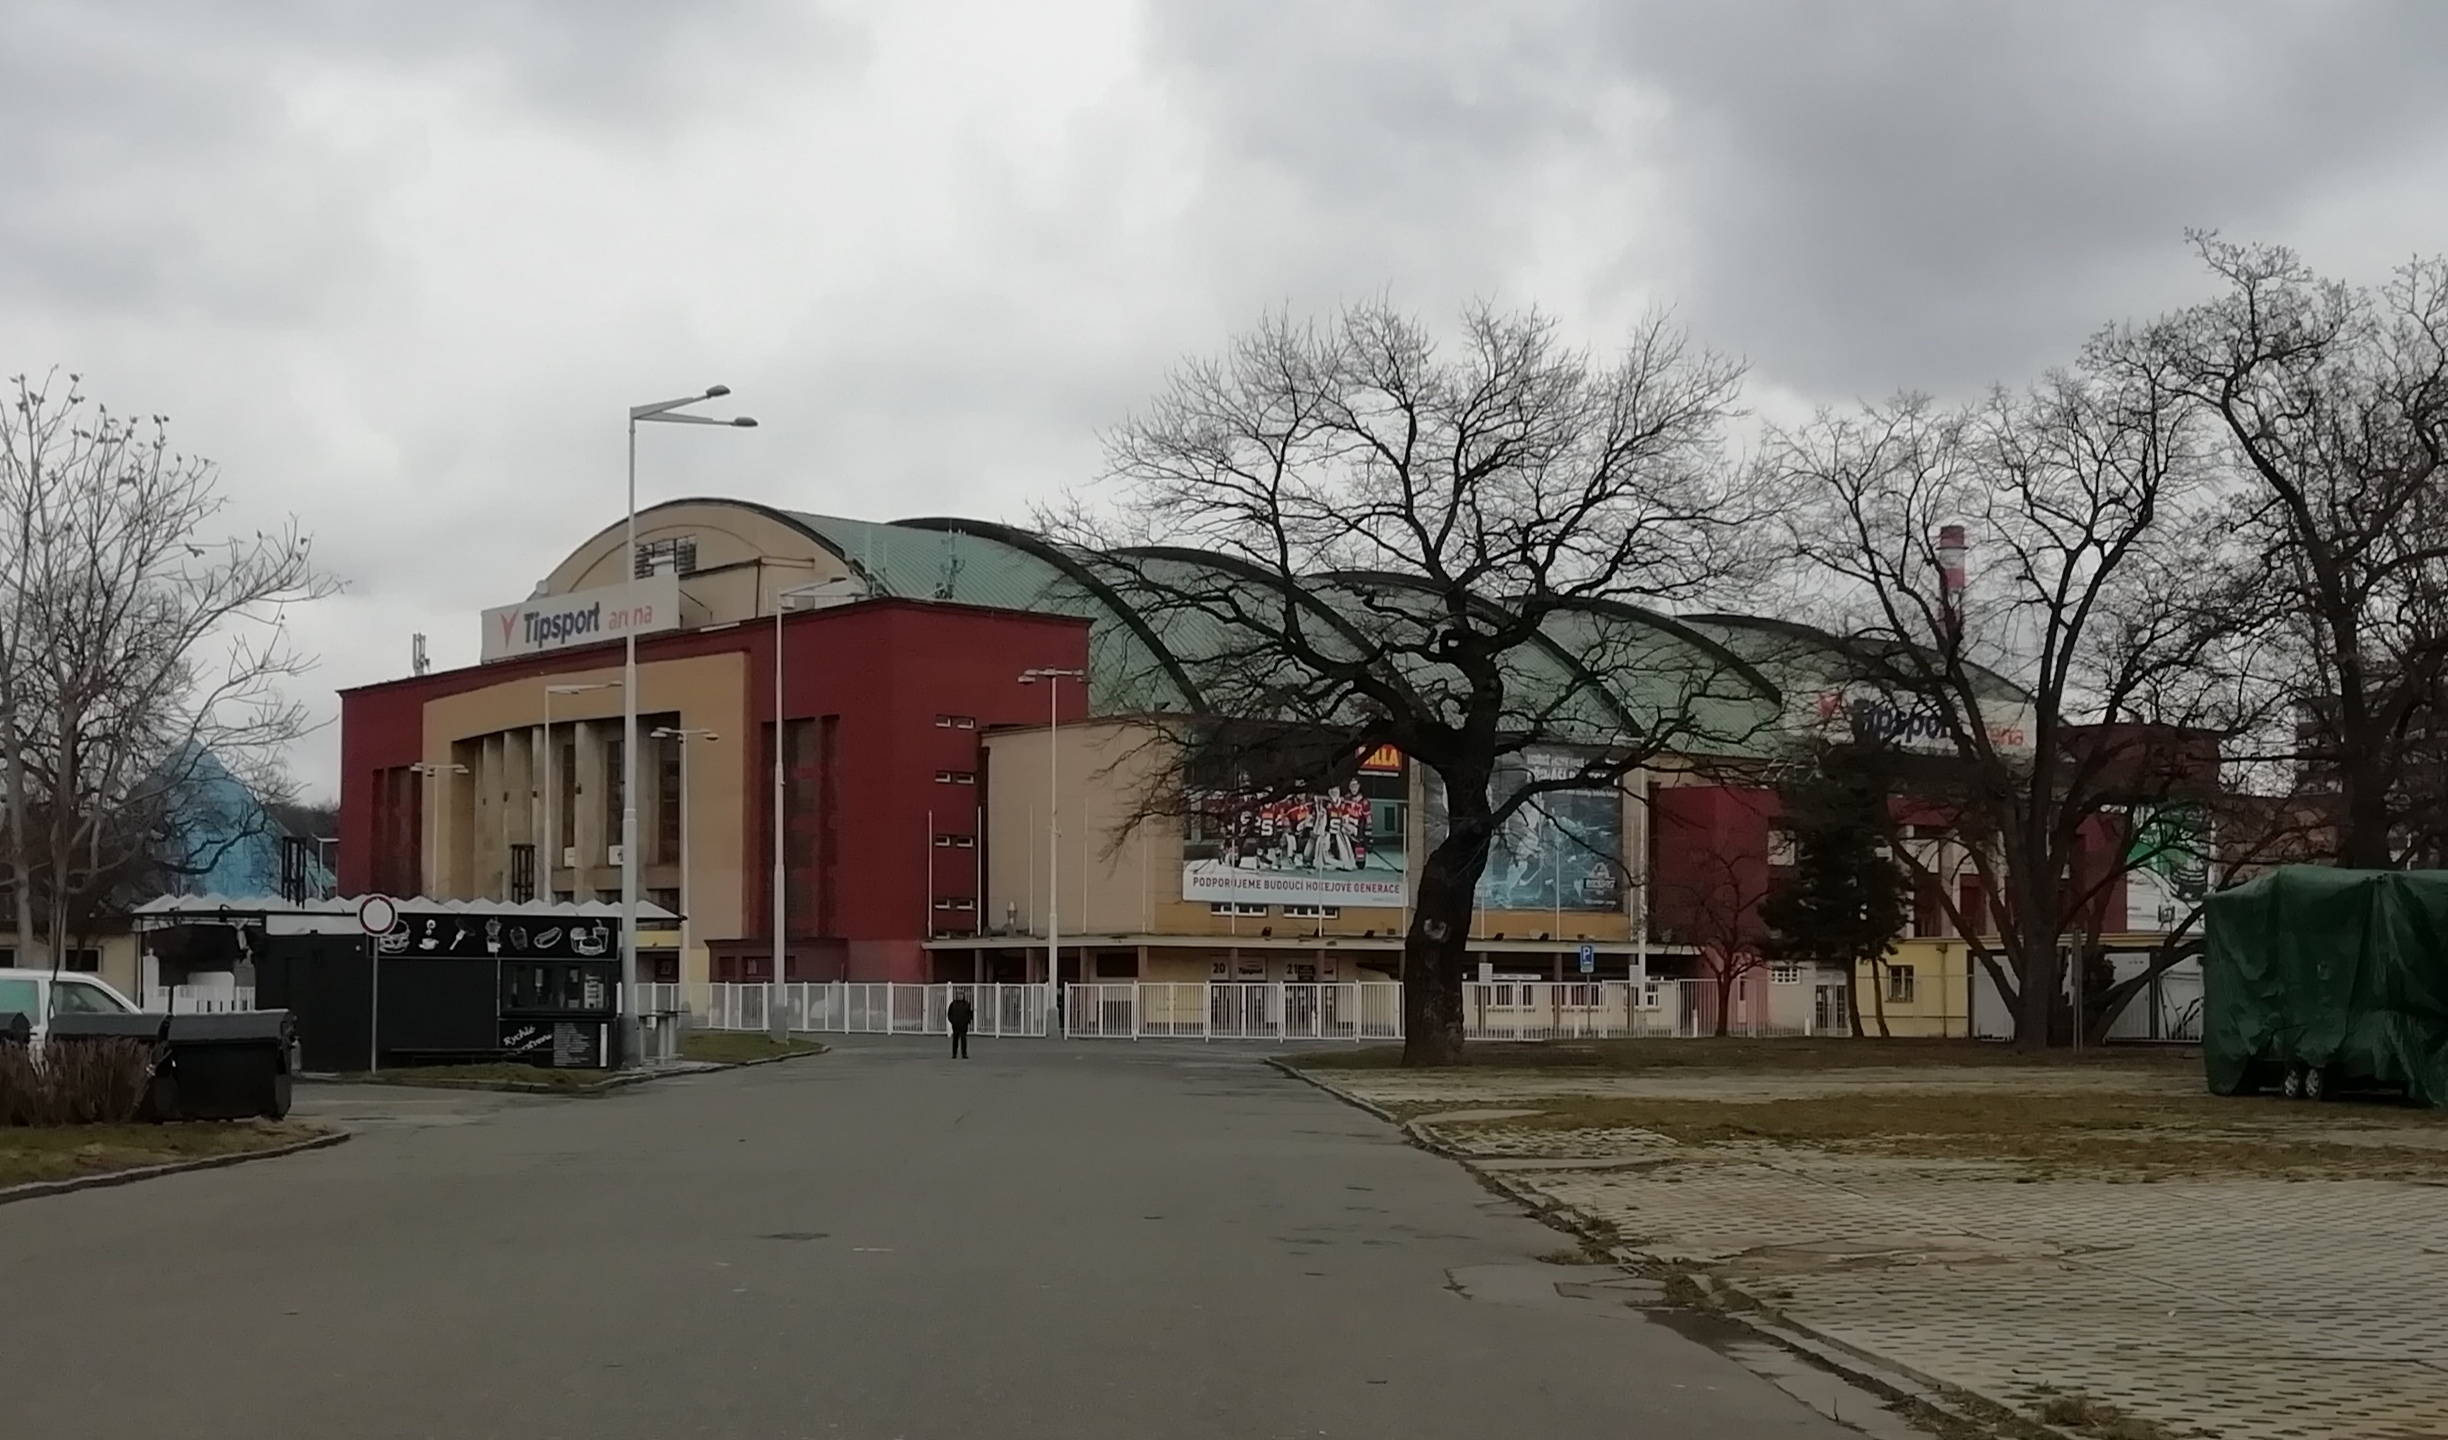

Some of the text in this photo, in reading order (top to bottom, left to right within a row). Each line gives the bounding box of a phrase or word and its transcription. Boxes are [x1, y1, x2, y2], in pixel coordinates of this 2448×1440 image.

[524, 601, 653, 648] Tipsport arna
[1583, 947, 1591, 960] P
[1213, 963, 1226, 974] 20
[1286, 963, 1298, 974] 21
